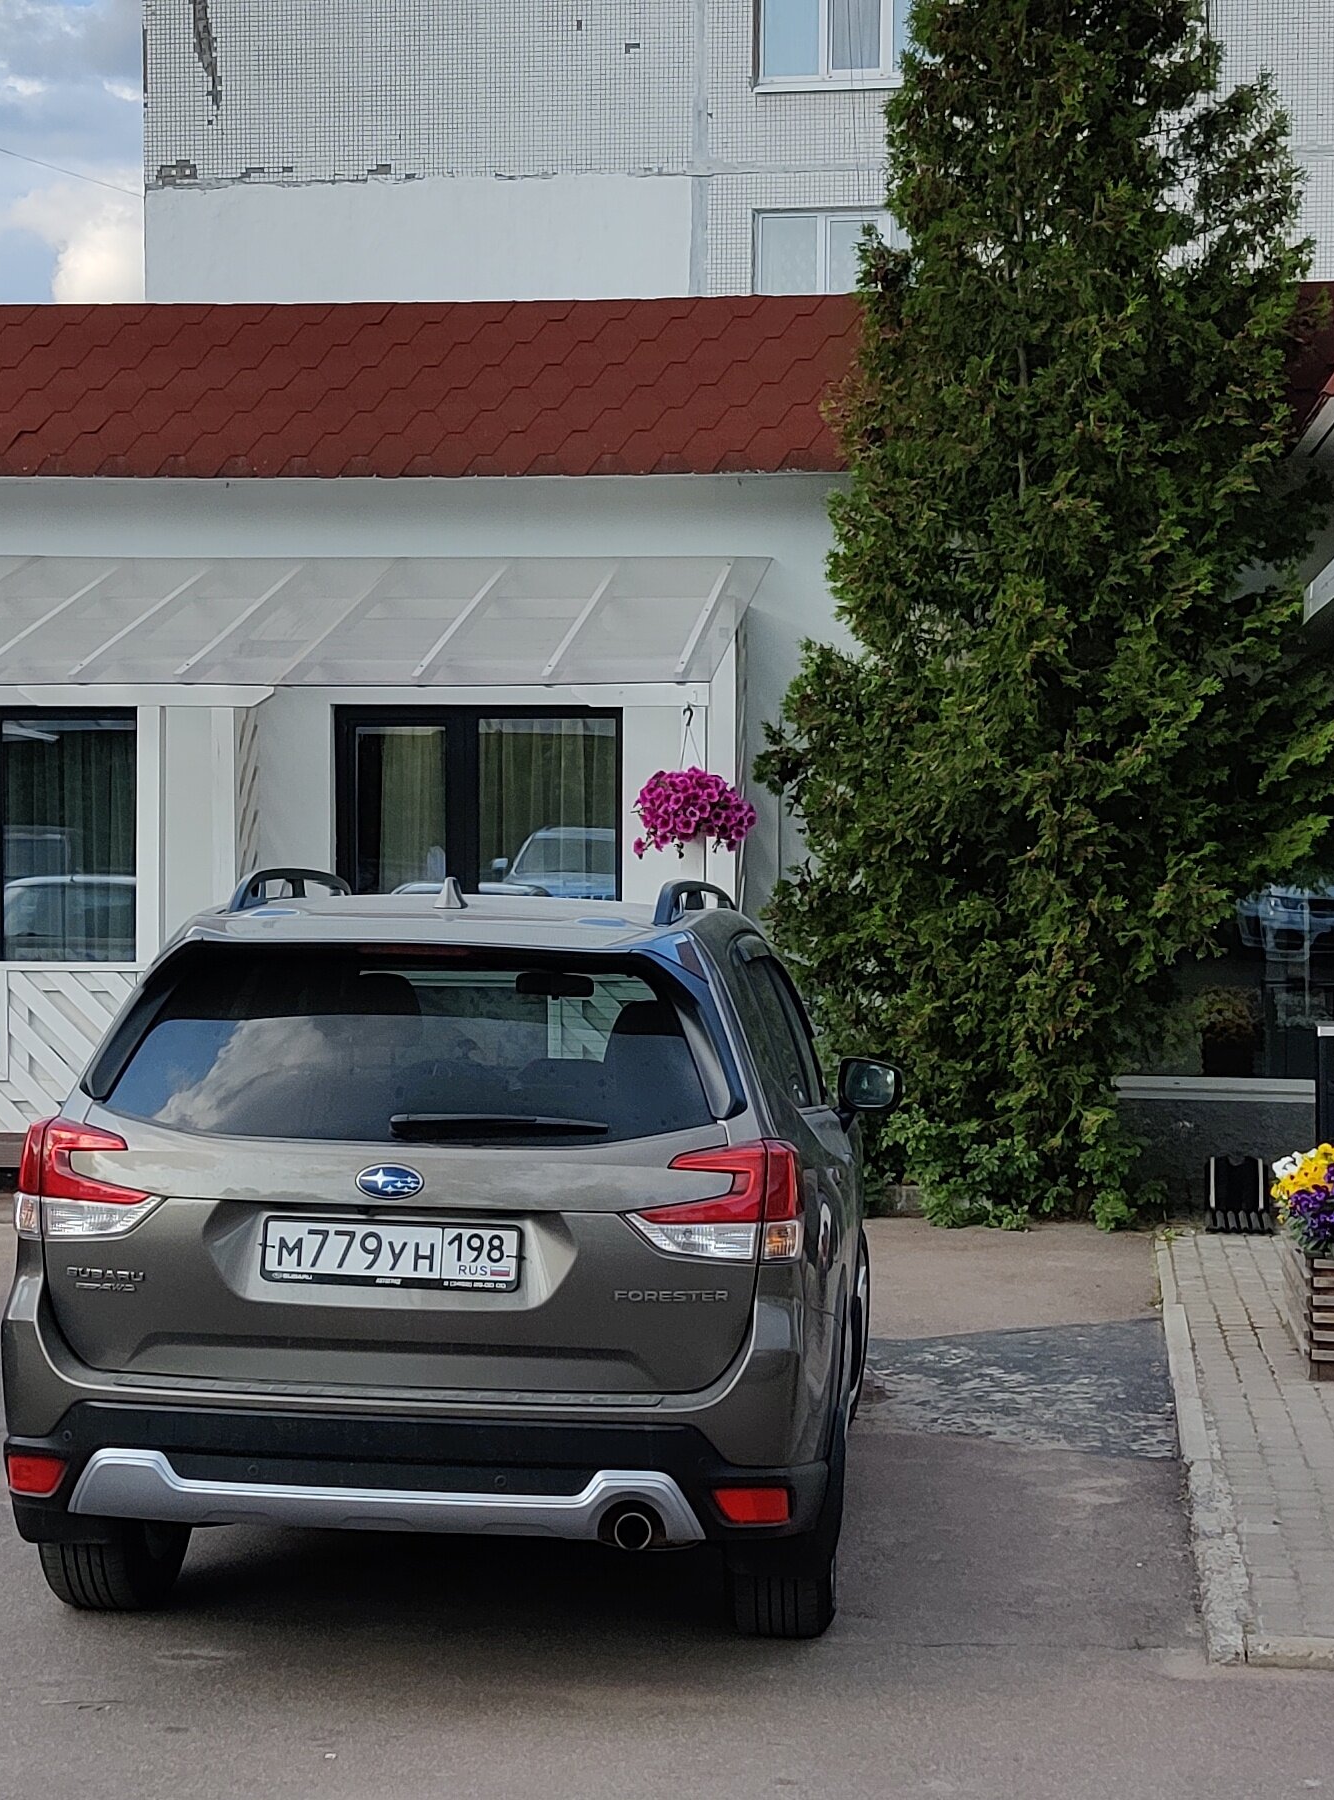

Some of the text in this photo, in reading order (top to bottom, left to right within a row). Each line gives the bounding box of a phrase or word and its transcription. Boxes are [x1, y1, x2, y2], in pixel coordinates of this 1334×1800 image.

[276, 1228, 505, 1273] М779УН 198
[66, 1266, 145, 1281] SUBARU
[458, 1264, 488, 1277] RUS
[613, 1290, 729, 1302] FORESTER
